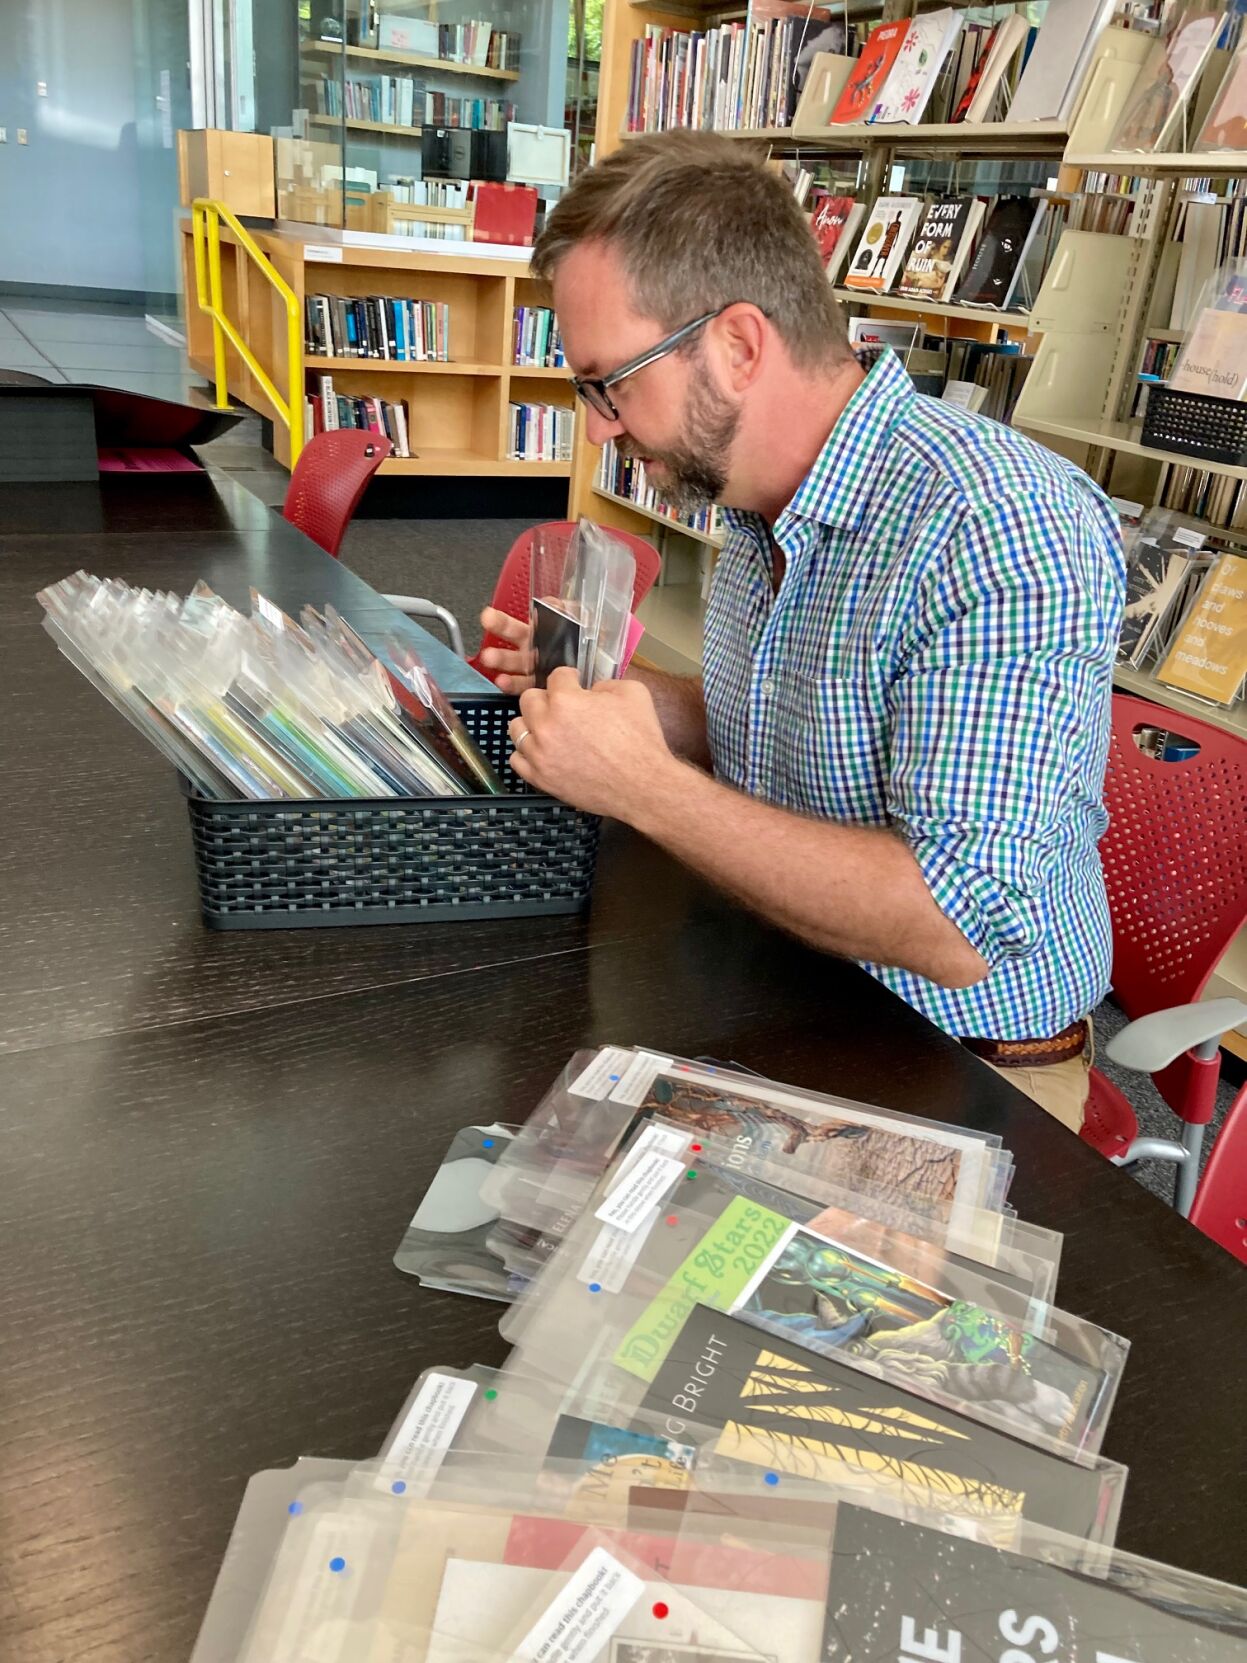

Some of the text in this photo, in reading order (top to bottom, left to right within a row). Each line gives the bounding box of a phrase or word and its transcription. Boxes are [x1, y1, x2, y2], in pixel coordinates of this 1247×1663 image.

[928, 204, 962, 220] EVERY
[920, 222, 953, 238] FORM
[915, 240, 932, 254] OF
[907, 258, 935, 273] RUIN
[1202, 600, 1225, 613] and
[1193, 616, 1234, 636] hooves
[1184, 632, 1205, 647] and
[1175, 649, 1229, 676] meadows
[720, 1135, 752, 1170] ions
[733, 1216, 786, 1276] 2022
[620, 1206, 762, 1368] Dwarf Stars
[672, 1334, 728, 1414] BRIGHT
[409, 1426, 422, 1442] read
[417, 1412, 429, 1427] this
[534, 1641, 552, 1660] can
[546, 1621, 567, 1644] read
[561, 1605, 579, 1625] this
[573, 1565, 611, 1609] chapbook!
[558, 1623, 584, 1652] gently
[577, 1608, 594, 1626] and
[589, 1595, 604, 1612] put
[604, 1570, 622, 1591] back
[566, 1637, 588, 1662] when
